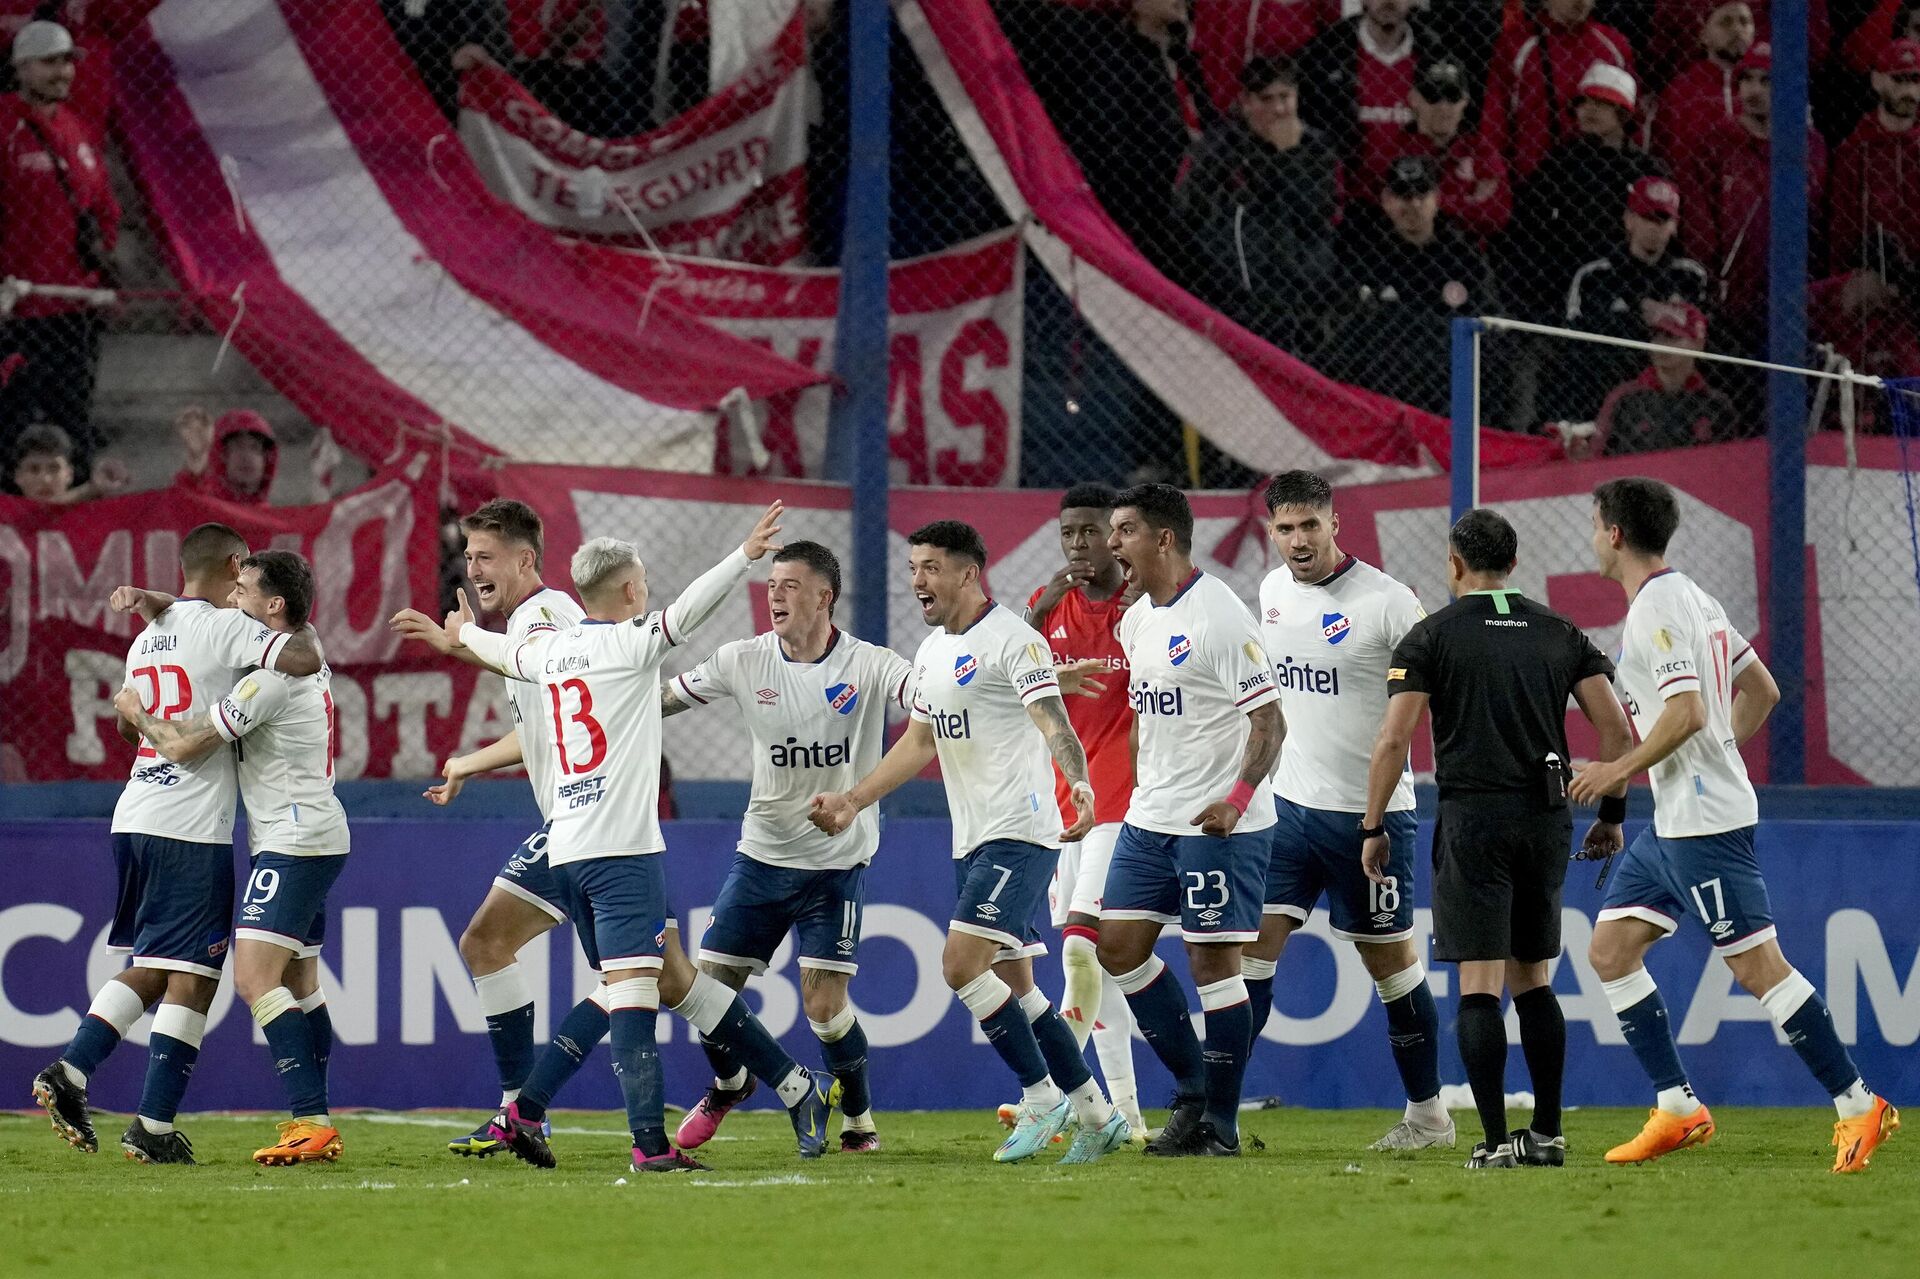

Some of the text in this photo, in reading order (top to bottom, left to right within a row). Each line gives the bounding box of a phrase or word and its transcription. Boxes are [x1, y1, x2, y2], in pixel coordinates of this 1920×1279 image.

[1484, 618, 1528, 628] marathon
[1277, 656, 1339, 696] antel
[1135, 681, 1182, 716] antel
[547, 678, 608, 776] 13
[770, 736, 851, 769] antel
[558, 776, 607, 798] ASSIST
[243, 868, 280, 904] 19
[988, 864, 1013, 902] 7
[1186, 870, 1230, 909] 23
[1369, 875, 1400, 913] 18
[1690, 877, 1726, 925] 17
[841, 900, 857, 939] 11
[976, 912, 997, 922] umbro
[1200, 919, 1221, 927] umbro
[1373, 921, 1394, 929] umbro
